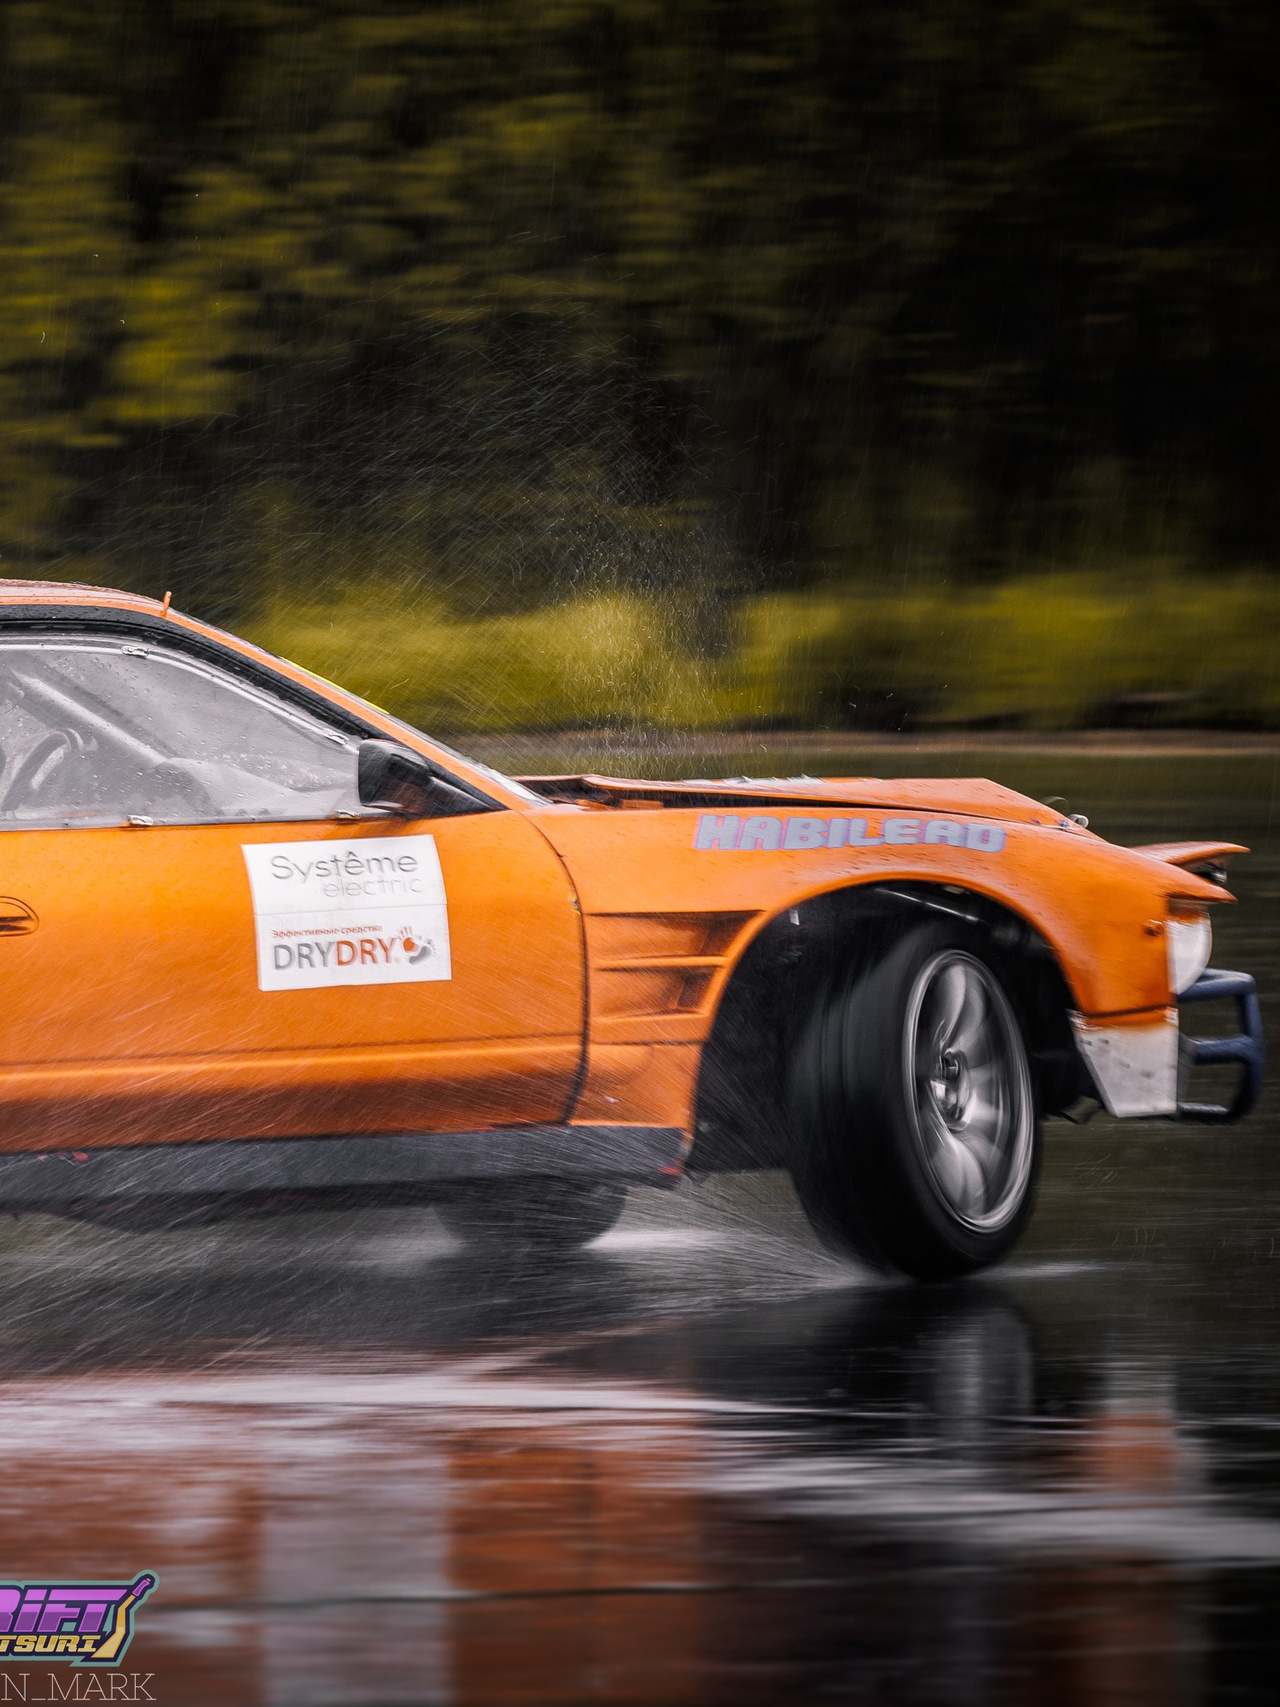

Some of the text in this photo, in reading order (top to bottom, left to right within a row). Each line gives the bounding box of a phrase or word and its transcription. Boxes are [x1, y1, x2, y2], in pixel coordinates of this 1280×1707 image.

[695, 815, 1006, 853] HABILEAD
[271, 851, 418, 883] Systême
[324, 878, 424, 897] electric
[273, 937, 395, 971] DRYDRY
